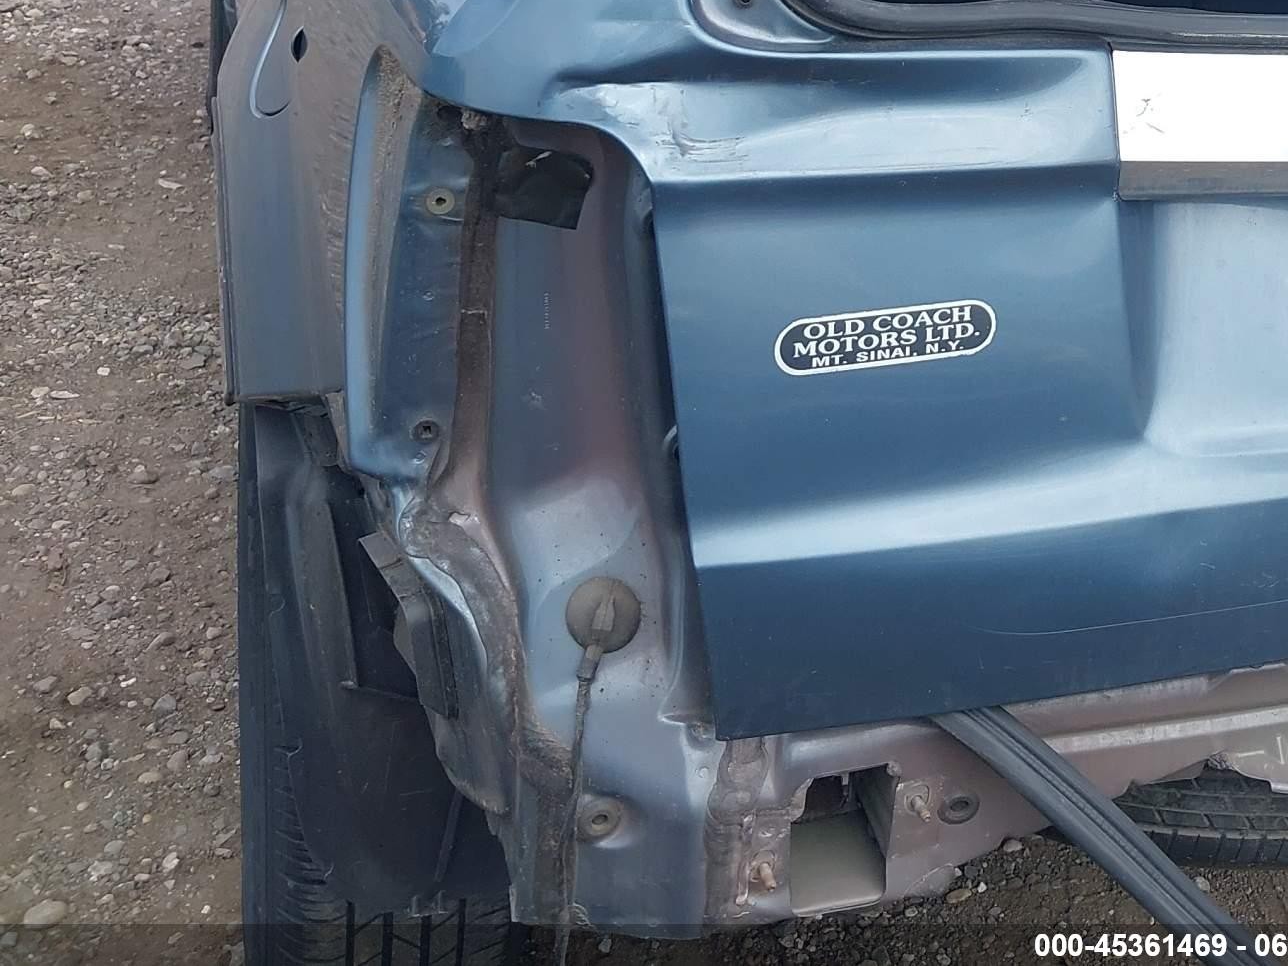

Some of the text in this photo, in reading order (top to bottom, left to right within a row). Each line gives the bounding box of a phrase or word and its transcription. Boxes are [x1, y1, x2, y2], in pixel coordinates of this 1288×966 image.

[803, 305, 972, 339] OLD COACH
[793, 322, 981, 358] MOTORS LTD.
[811, 354, 847, 367] MT.
[925, 340, 965, 354] N.Y.
